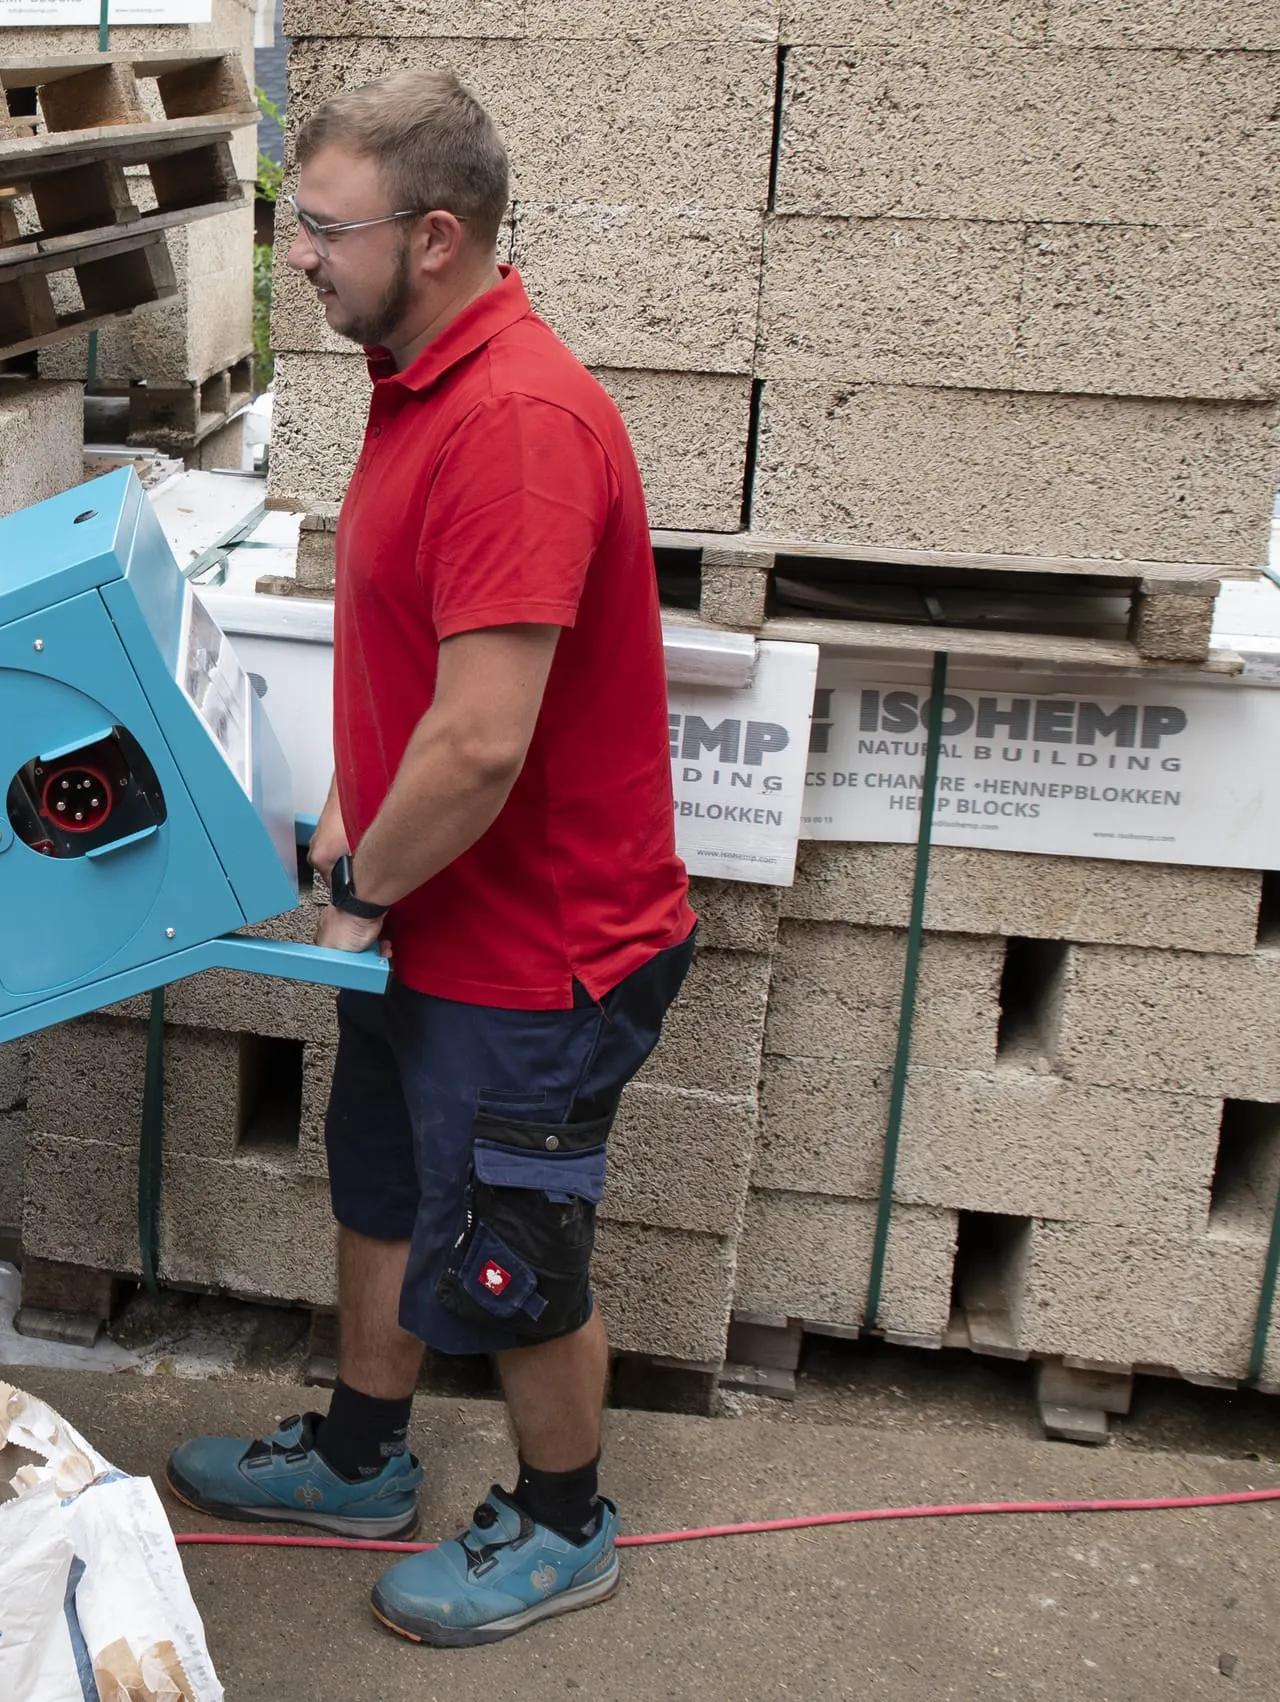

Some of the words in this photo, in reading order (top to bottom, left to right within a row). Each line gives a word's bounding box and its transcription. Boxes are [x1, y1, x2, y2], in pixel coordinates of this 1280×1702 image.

[859, 689, 1188, 750] ISOHEMP
[974, 746, 1182, 772] BUILDING
[832, 772, 859, 787] DE
[864, 773, 965, 792] CHANRE
[889, 795, 950, 812] HEP
[956, 799, 1041, 818] BLOCKS
[696, 849, 778, 865] www.isohemp.com
